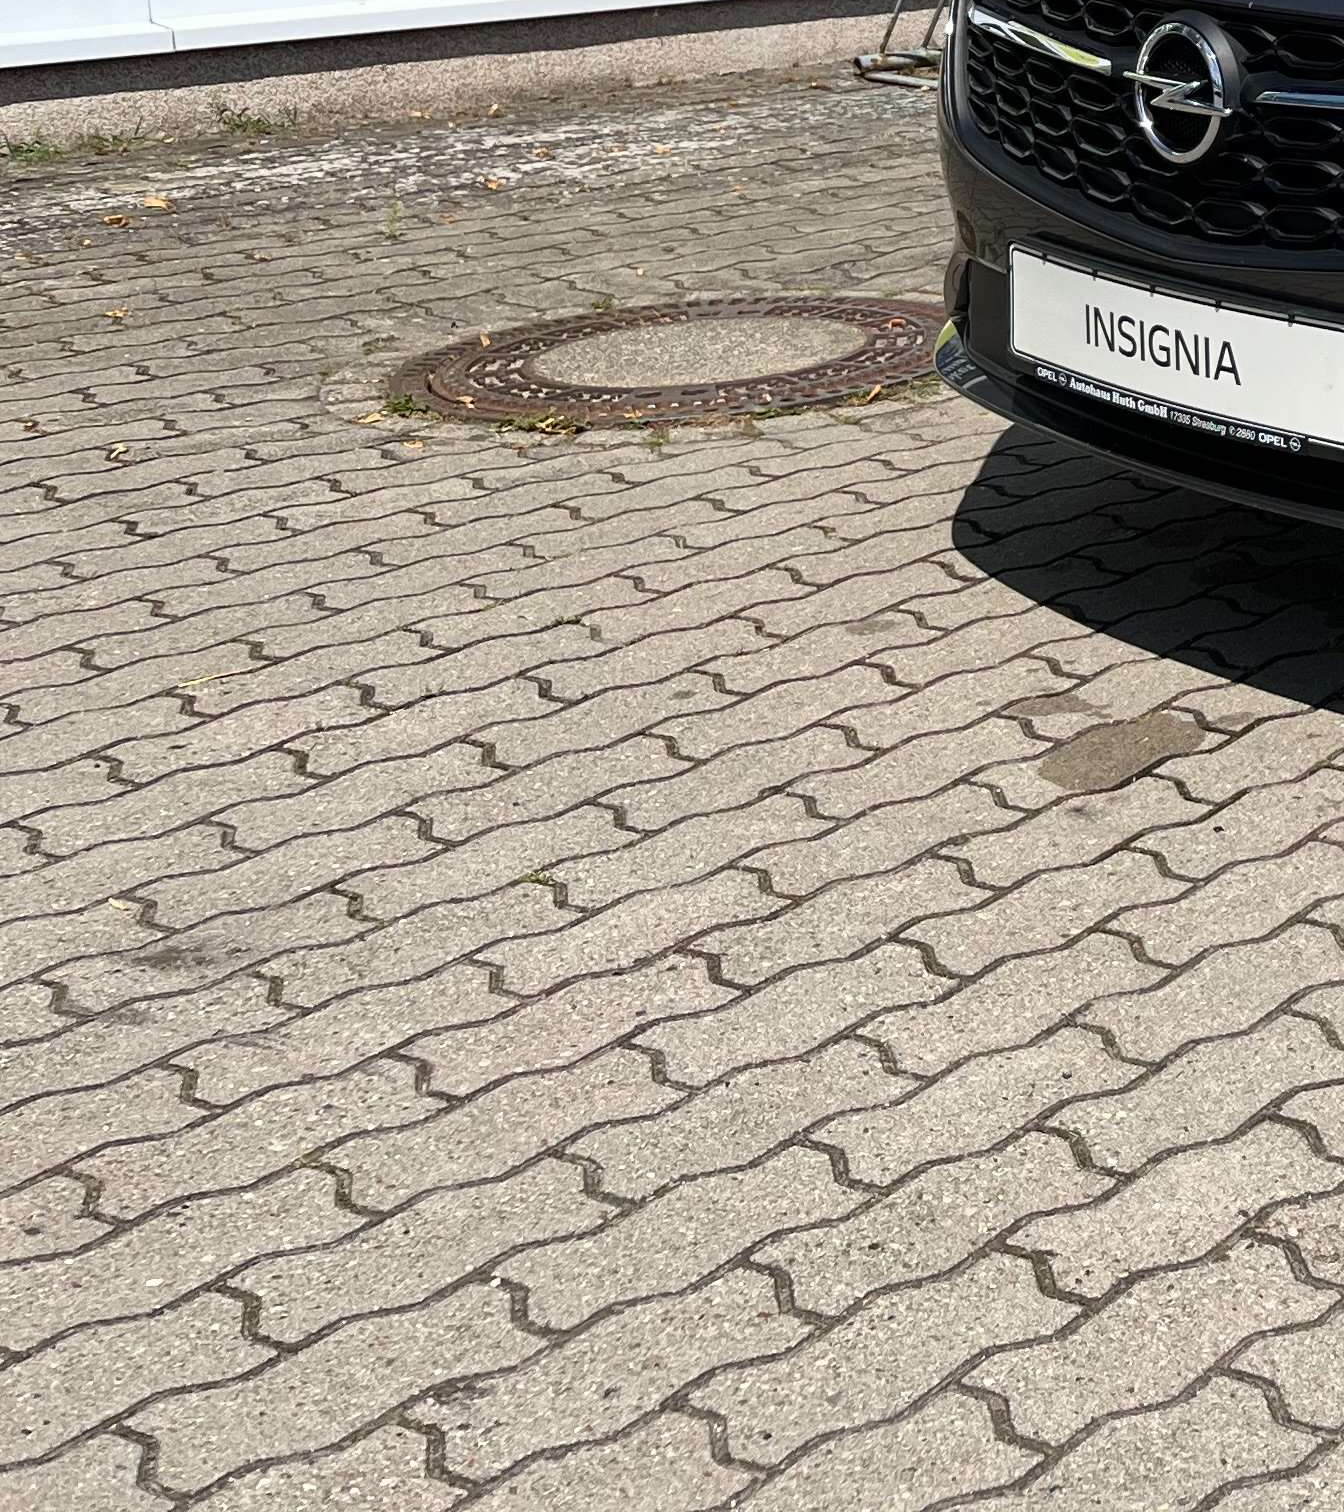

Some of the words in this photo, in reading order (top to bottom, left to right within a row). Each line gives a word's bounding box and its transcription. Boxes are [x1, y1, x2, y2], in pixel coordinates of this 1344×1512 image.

[1084, 303, 1242, 386] INSIGNIA
[1037, 367, 1058, 383] OPEL
[1069, 377, 1111, 402] Autohaus
[1112, 391, 1136, 409] Huth
[1137, 399, 1168, 419] GmbH
[1258, 432, 1288, 448] OPEL
